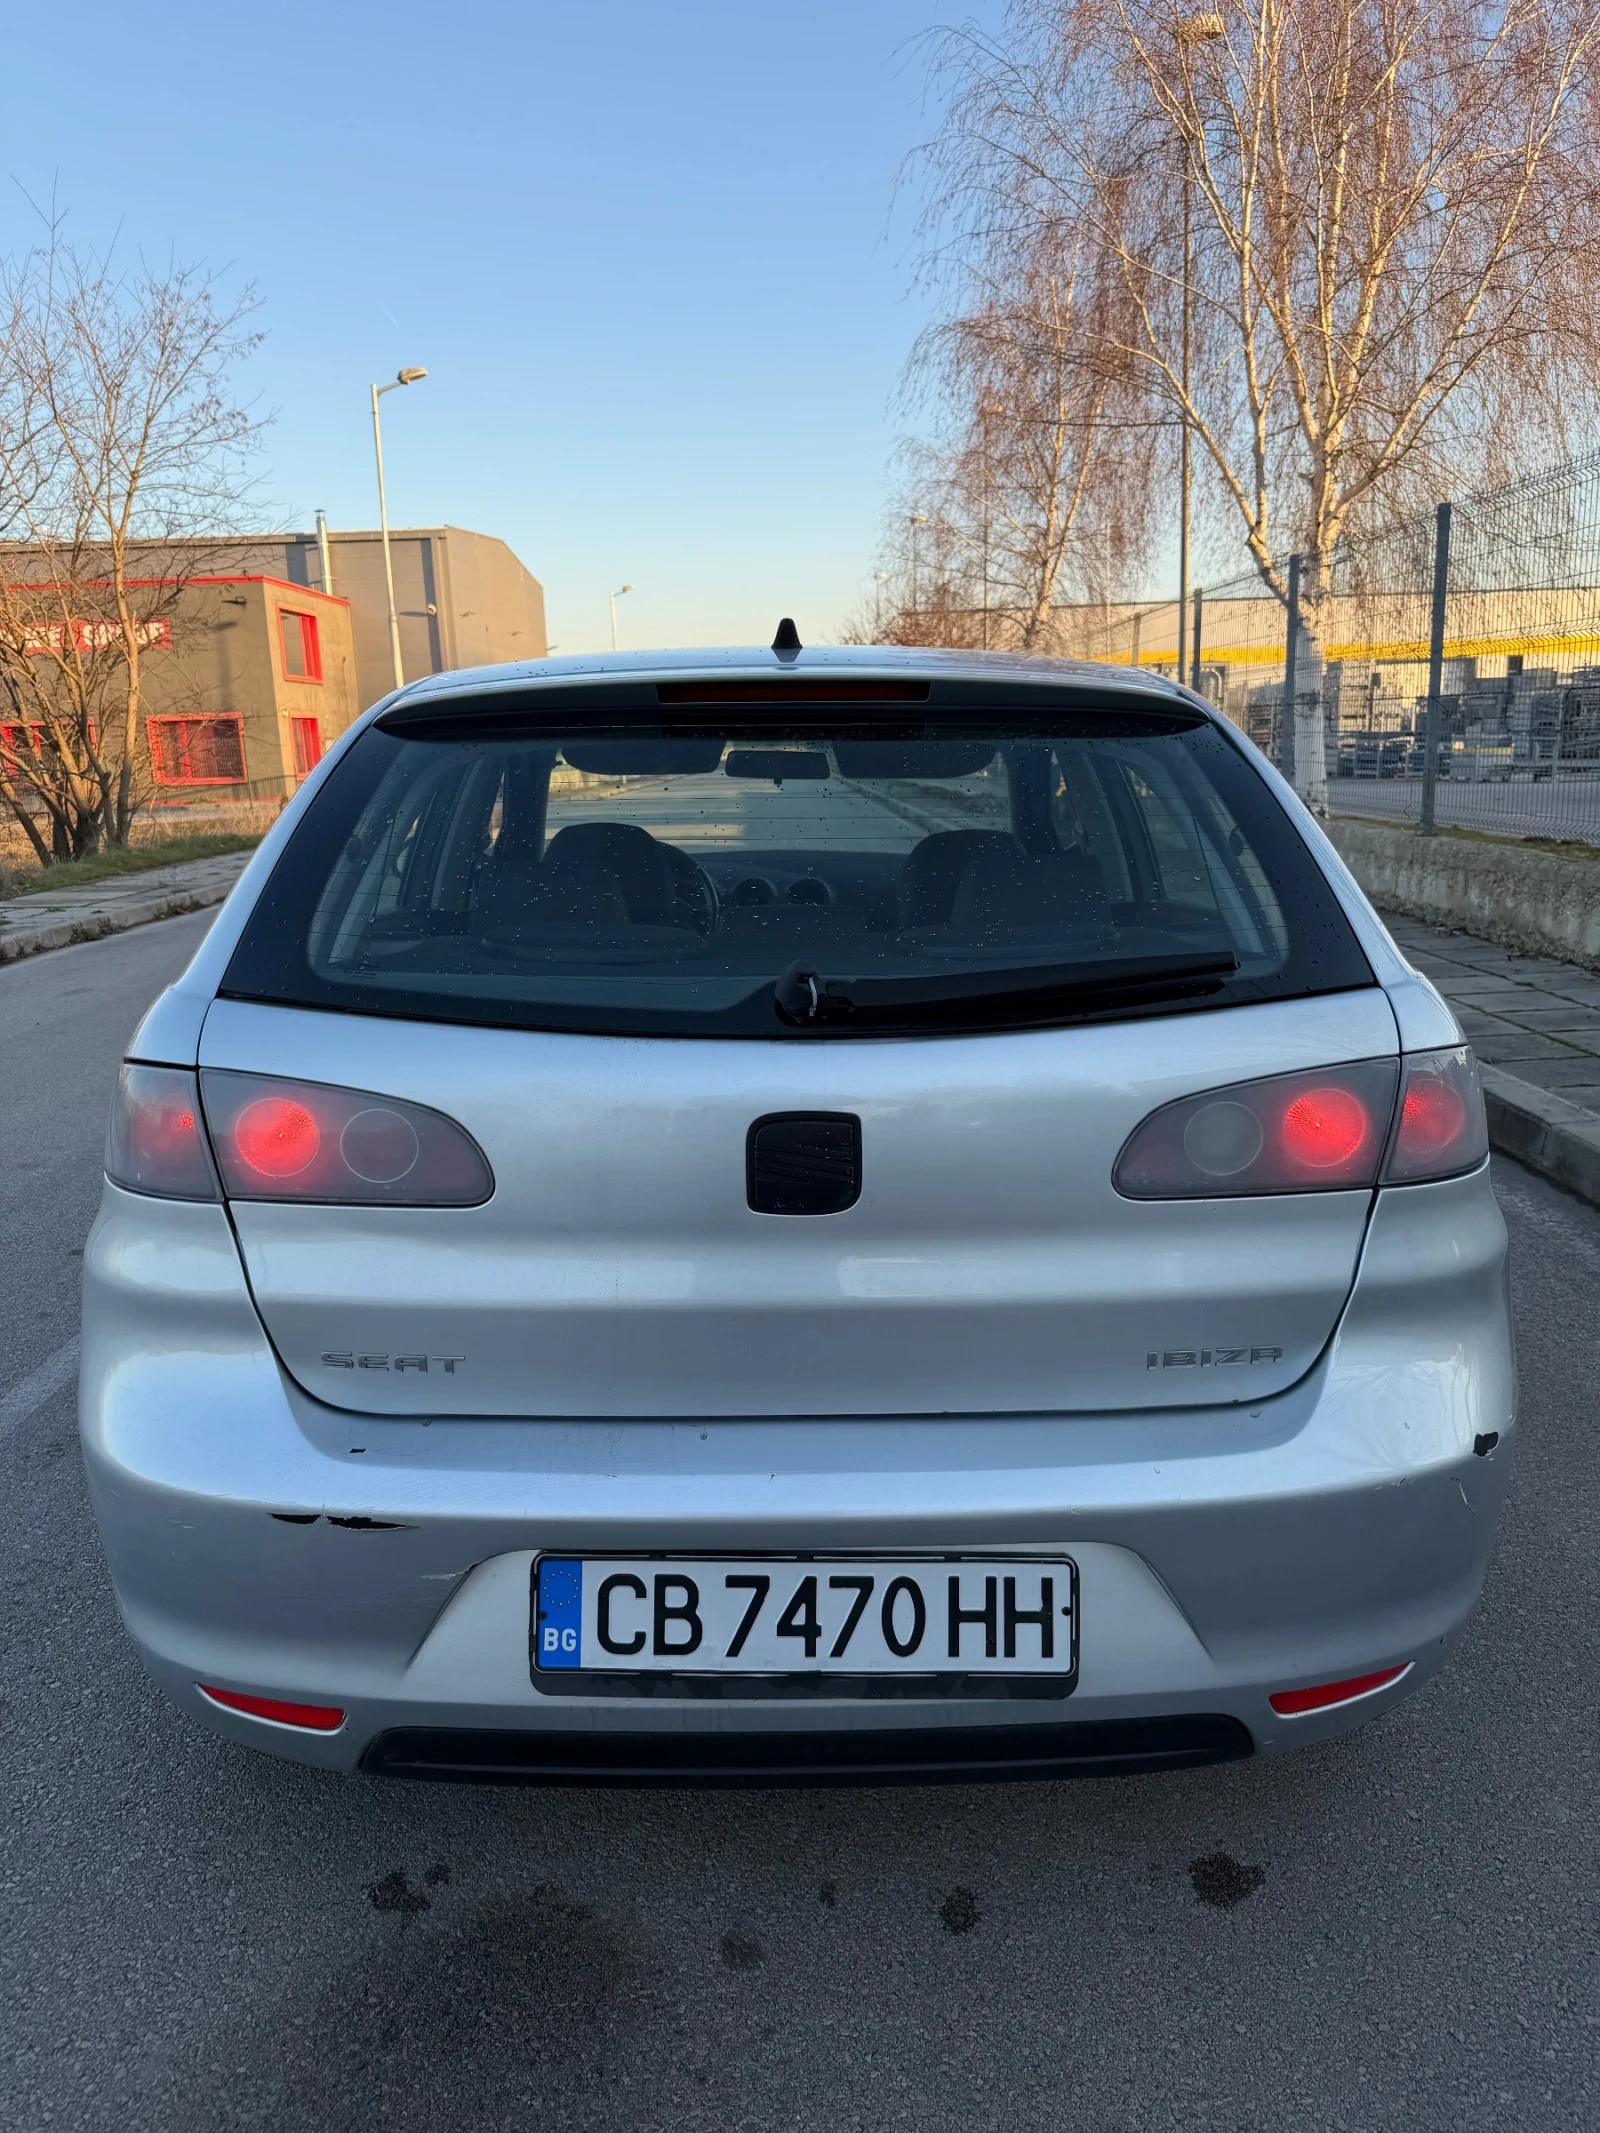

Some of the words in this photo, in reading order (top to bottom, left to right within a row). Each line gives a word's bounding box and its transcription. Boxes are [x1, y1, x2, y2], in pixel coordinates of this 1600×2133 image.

[321, 1351, 466, 1374] SEAT
[1147, 1345, 1283, 1371] IBIZA
[597, 1573, 702, 1656] CB
[724, 1575, 927, 1658] 7470
[948, 1576, 1054, 1658] HH
[543, 1627, 577, 1652] BG
